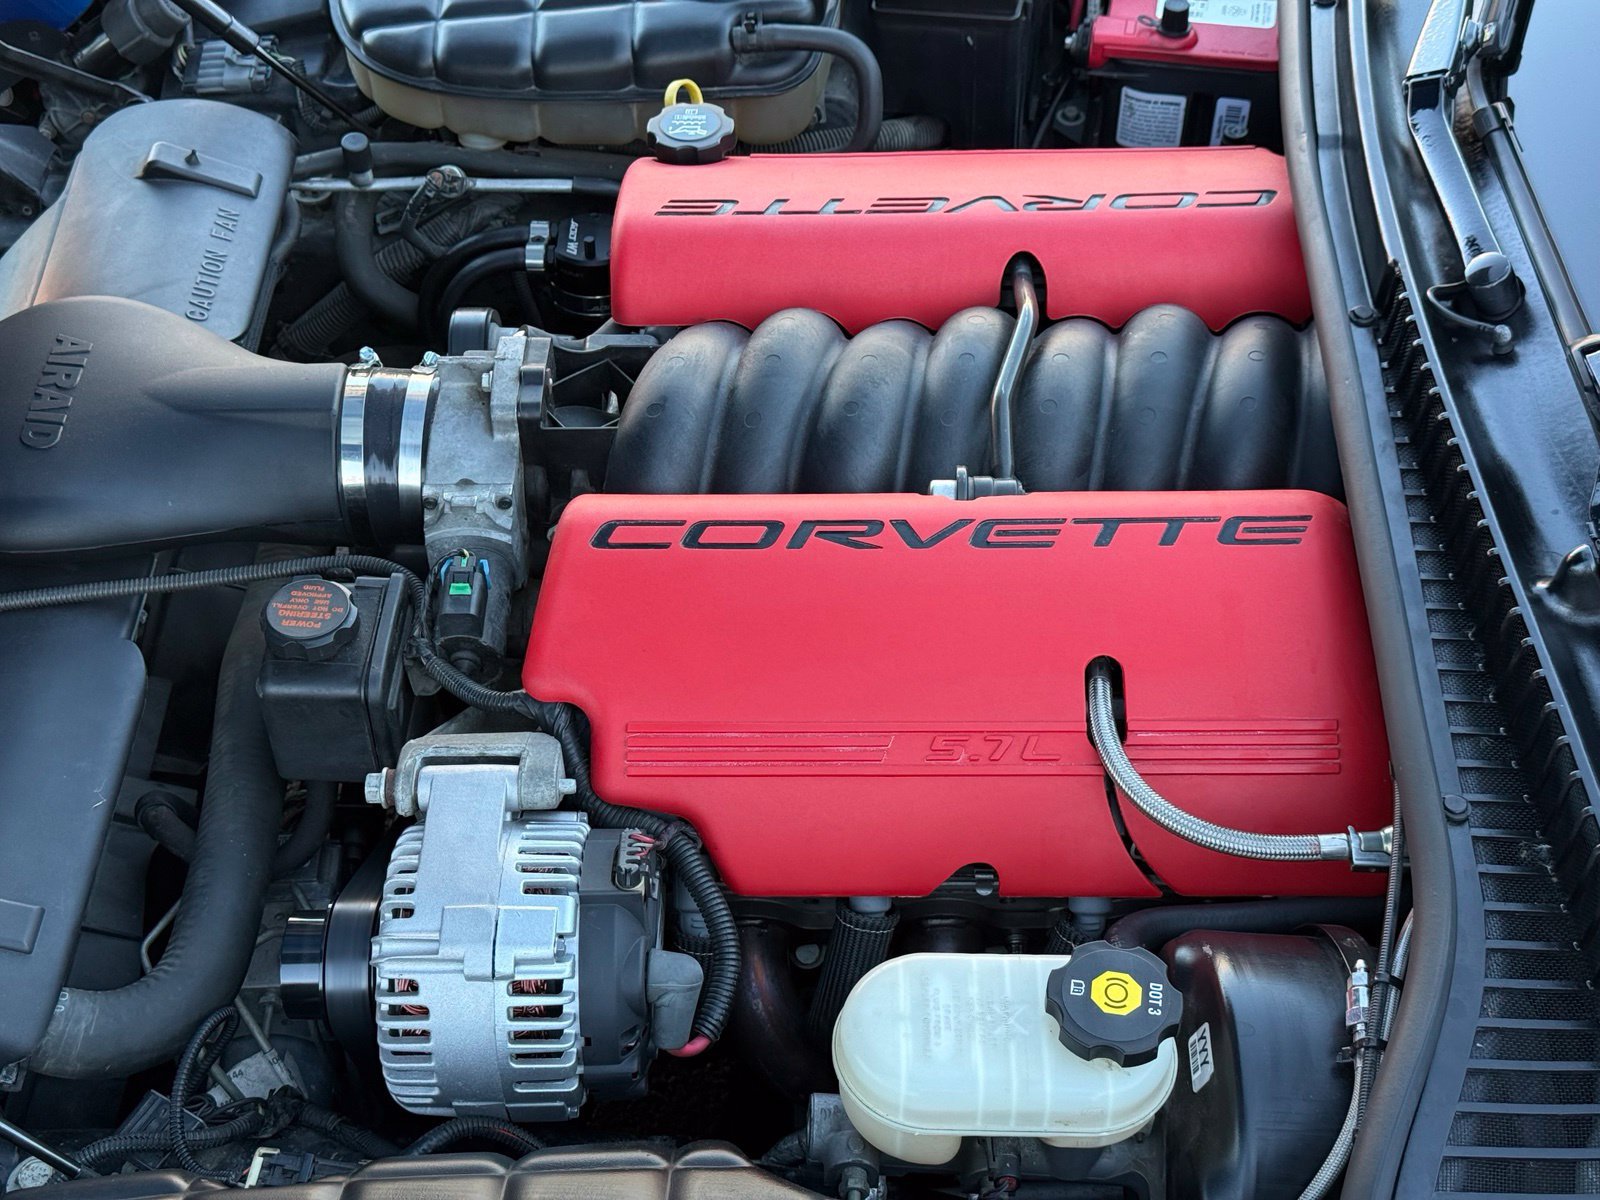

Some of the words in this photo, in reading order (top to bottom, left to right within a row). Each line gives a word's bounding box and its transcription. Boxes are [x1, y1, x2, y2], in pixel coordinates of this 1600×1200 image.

[654, 189, 1278, 216] CORVETTE
[185, 248, 228, 321] CAUTION
[210, 207, 240, 242] FAN
[20, 333, 93, 451] AIRAID
[589, 515, 1313, 549] CORVETTE
[279, 610, 331, 619] STEERING
[281, 619, 321, 628] POWER
[925, 734, 1061, 762] 5.7L
[1148, 982, 1164, 1007] DOT
[1147, 1007, 1162, 1016] 3
[1197, 1027, 1210, 1067] YYY
